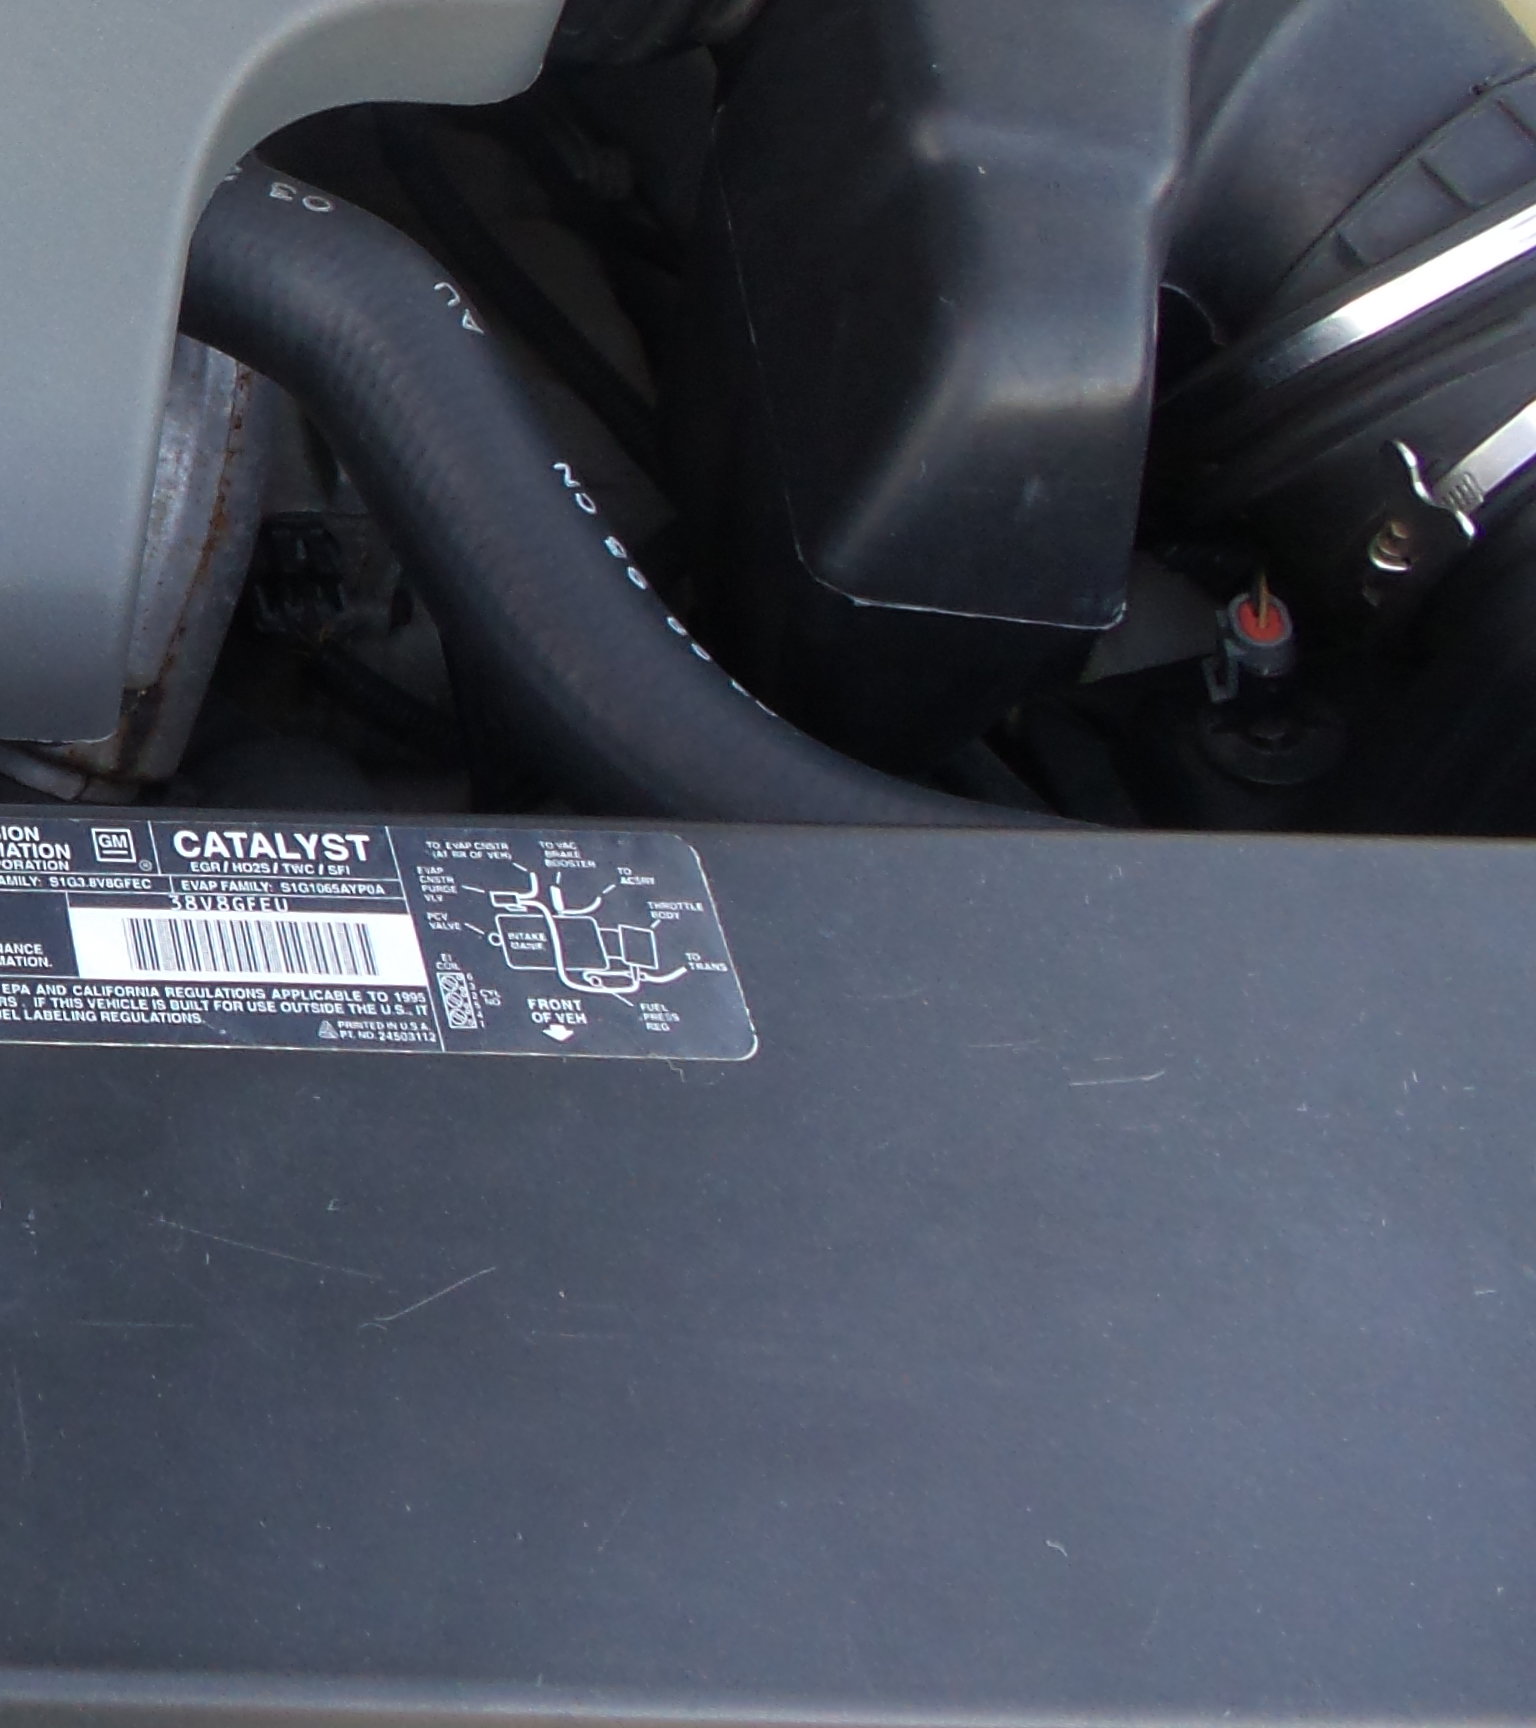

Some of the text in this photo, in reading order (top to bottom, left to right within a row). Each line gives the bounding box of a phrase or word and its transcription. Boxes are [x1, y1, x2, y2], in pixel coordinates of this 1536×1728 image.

[97, 834, 128, 849] GM
[173, 829, 371, 862] CATALYST
[181, 880, 273, 893] EVAP FAMILY:
[528, 998, 581, 1011] FRONT
[531, 1011, 588, 1024] OF VEH
